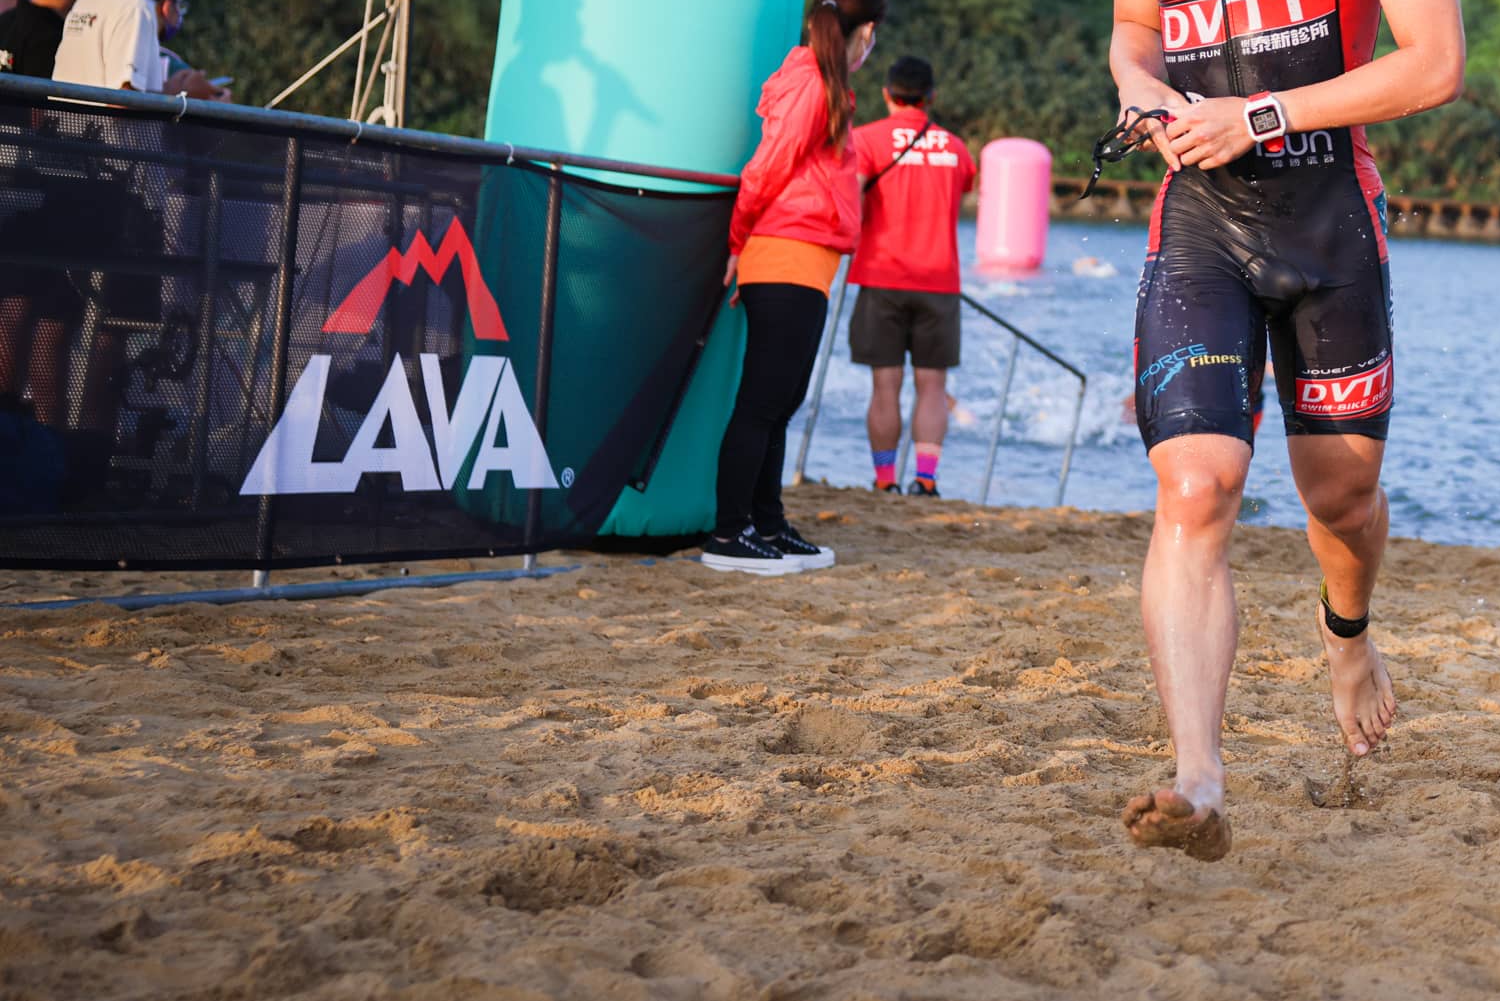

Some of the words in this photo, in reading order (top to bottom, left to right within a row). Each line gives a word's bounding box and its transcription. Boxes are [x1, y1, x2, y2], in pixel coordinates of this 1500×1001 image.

[892, 128, 949, 149] STAFF
[1140, 343, 1208, 386] FORCE
[1190, 353, 1242, 368] Fitness
[1302, 360, 1391, 403] DVTT
[239, 351, 560, 496] LAVA
